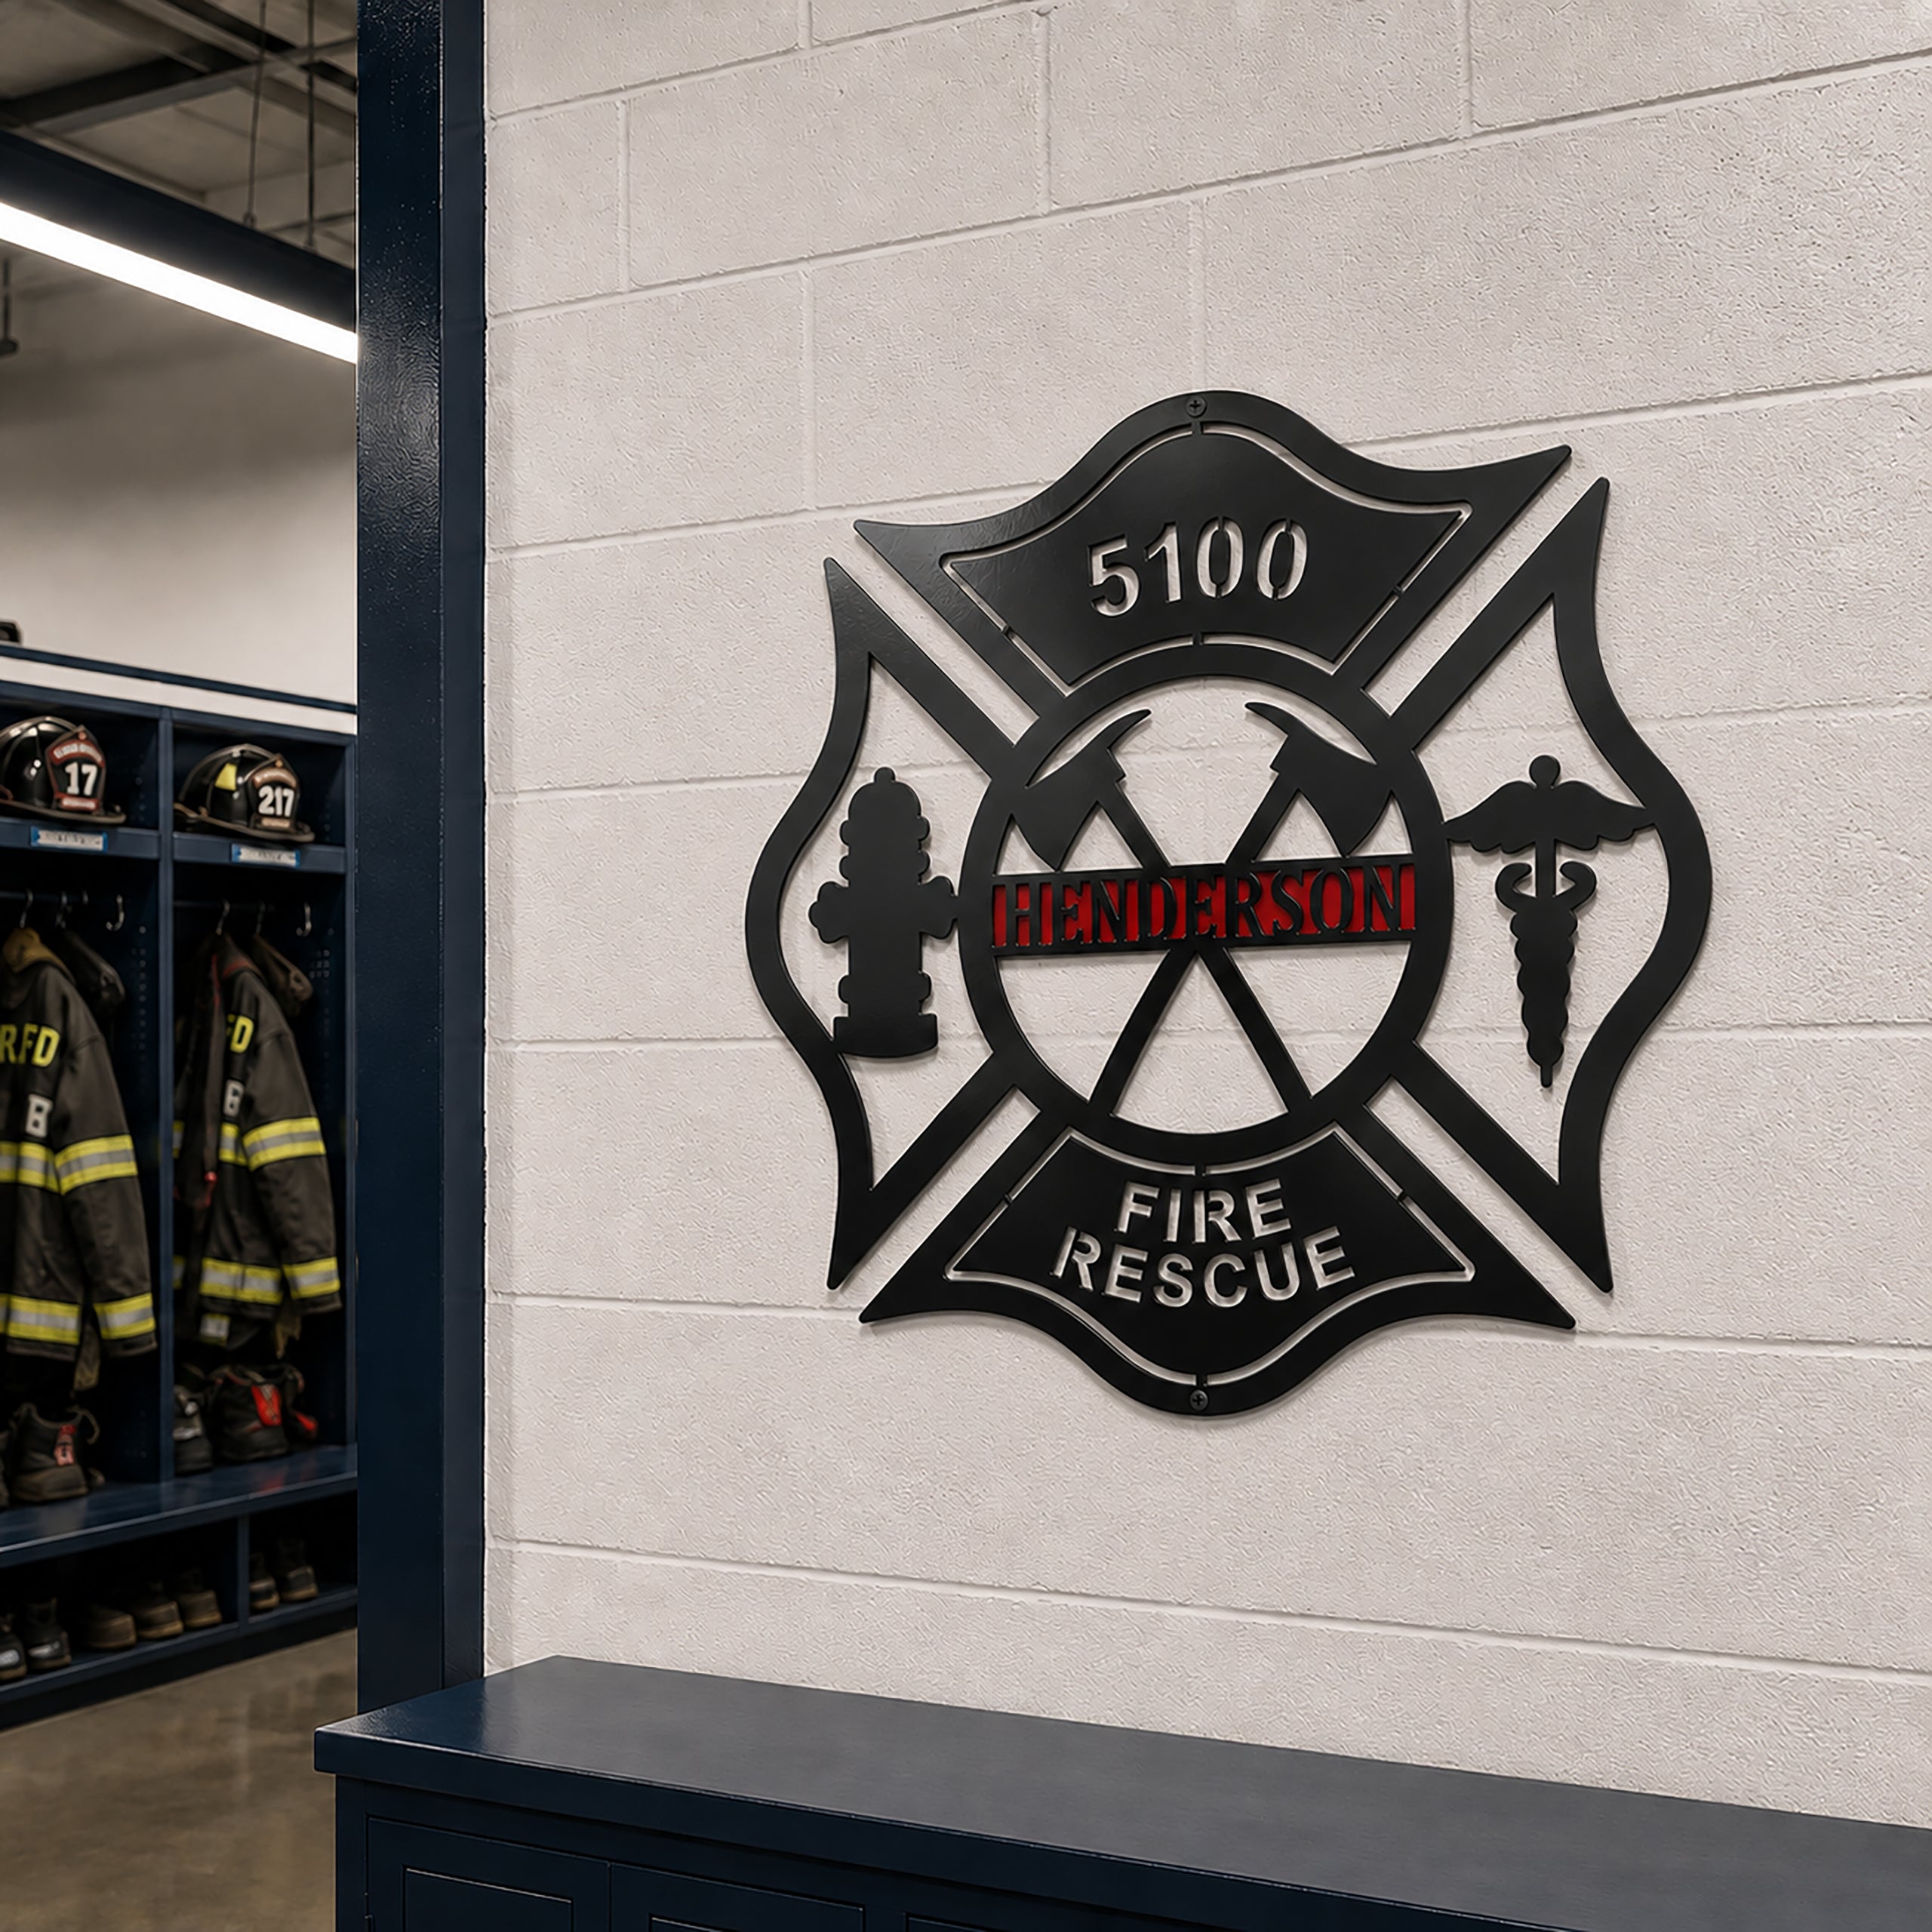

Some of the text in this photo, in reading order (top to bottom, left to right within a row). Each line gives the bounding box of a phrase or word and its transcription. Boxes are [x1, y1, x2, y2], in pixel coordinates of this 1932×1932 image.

[1088, 515, 1308, 617] 5100
[65, 762, 97, 795] 17
[258, 786, 294, 817] 217
[998, 866, 1407, 948] HENDERSON
[1114, 1178, 1291, 1244] FIRE
[1050, 1226, 1355, 1308] RESCUE
